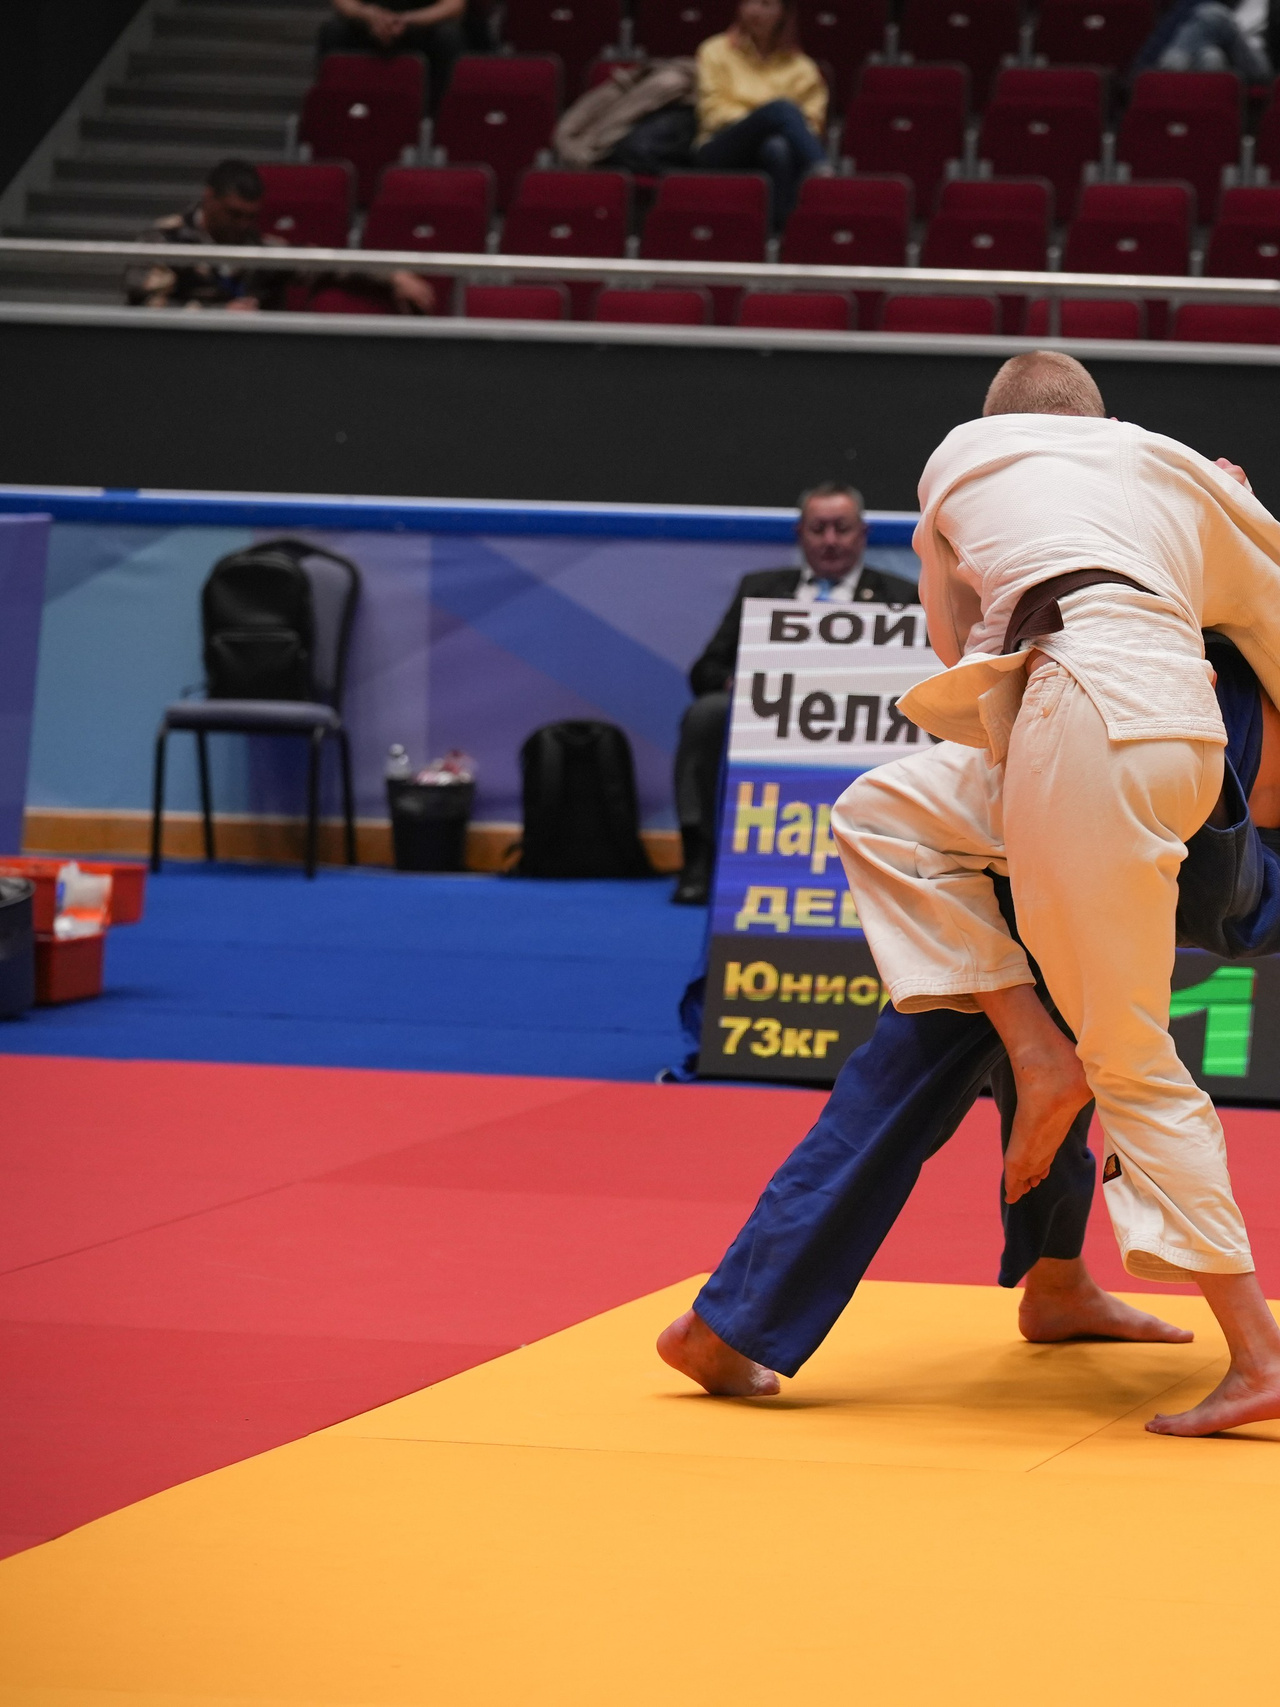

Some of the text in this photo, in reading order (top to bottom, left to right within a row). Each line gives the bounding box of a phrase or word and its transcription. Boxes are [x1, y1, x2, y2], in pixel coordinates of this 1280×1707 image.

[769, 602, 932, 648] БОЙ
[752, 672, 945, 744] Челя
[723, 960, 892, 1015] Юнио
[719, 1015, 840, 1059] 73кг
